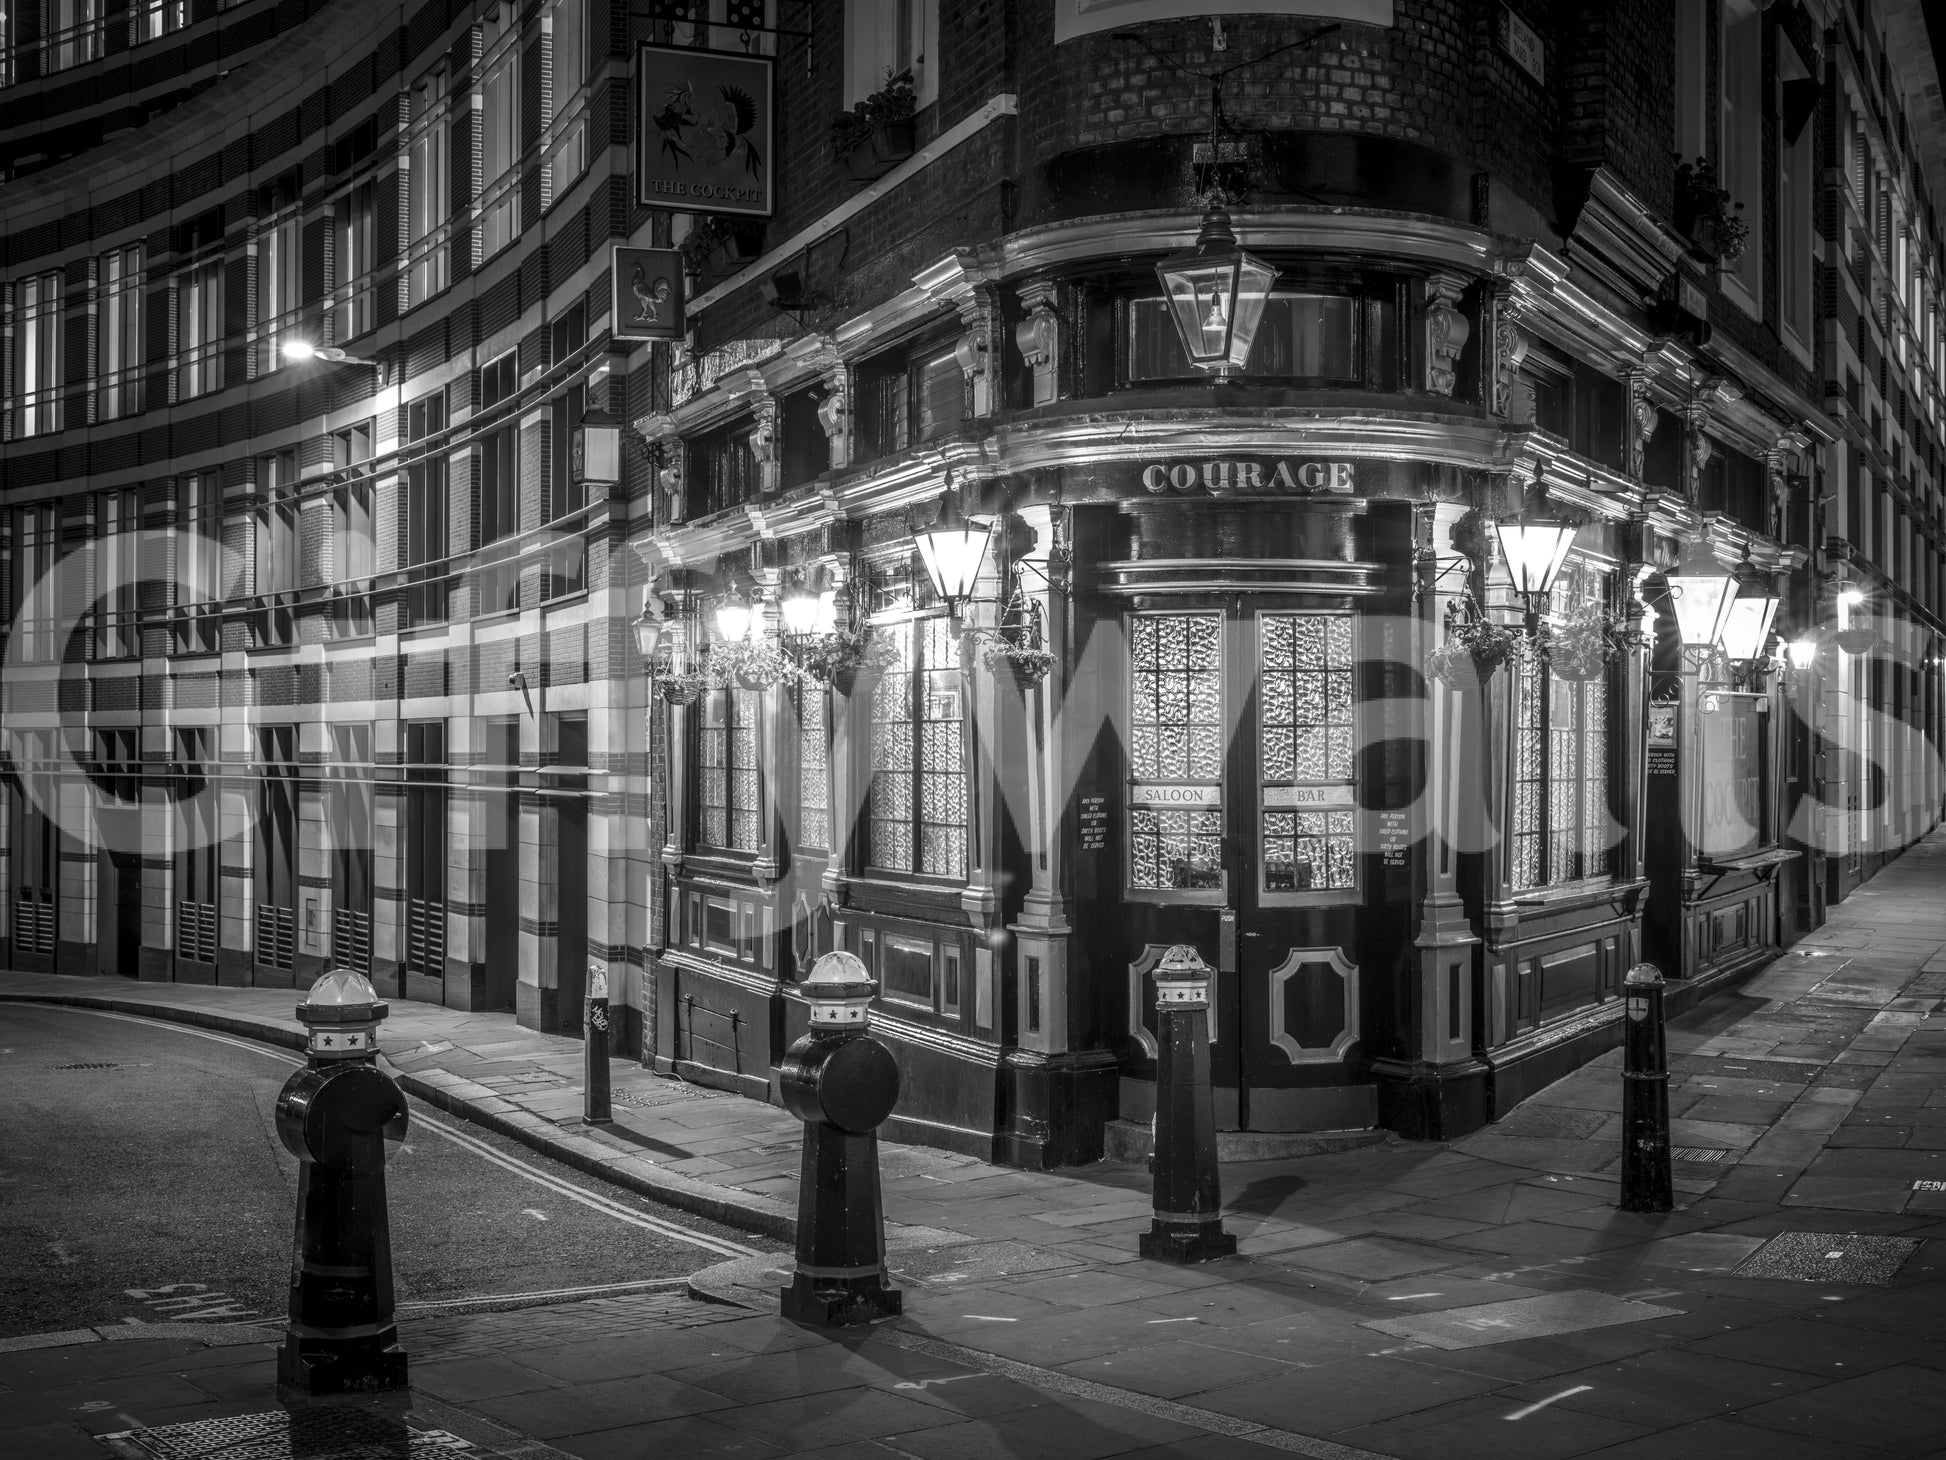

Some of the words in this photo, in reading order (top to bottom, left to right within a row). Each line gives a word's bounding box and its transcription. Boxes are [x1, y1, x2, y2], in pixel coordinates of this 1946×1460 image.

[1513, 38, 1528, 64] YARD
[651, 178, 687, 196] THE
[690, 182, 763, 204] COCKPIT
[1142, 460, 1355, 494] COURAGE
[1719, 716, 1747, 760] THE
[1145, 788, 1204, 802] SALOON
[1296, 789, 1326, 802] BAR
[1389, 858, 1406, 866] SERVED
